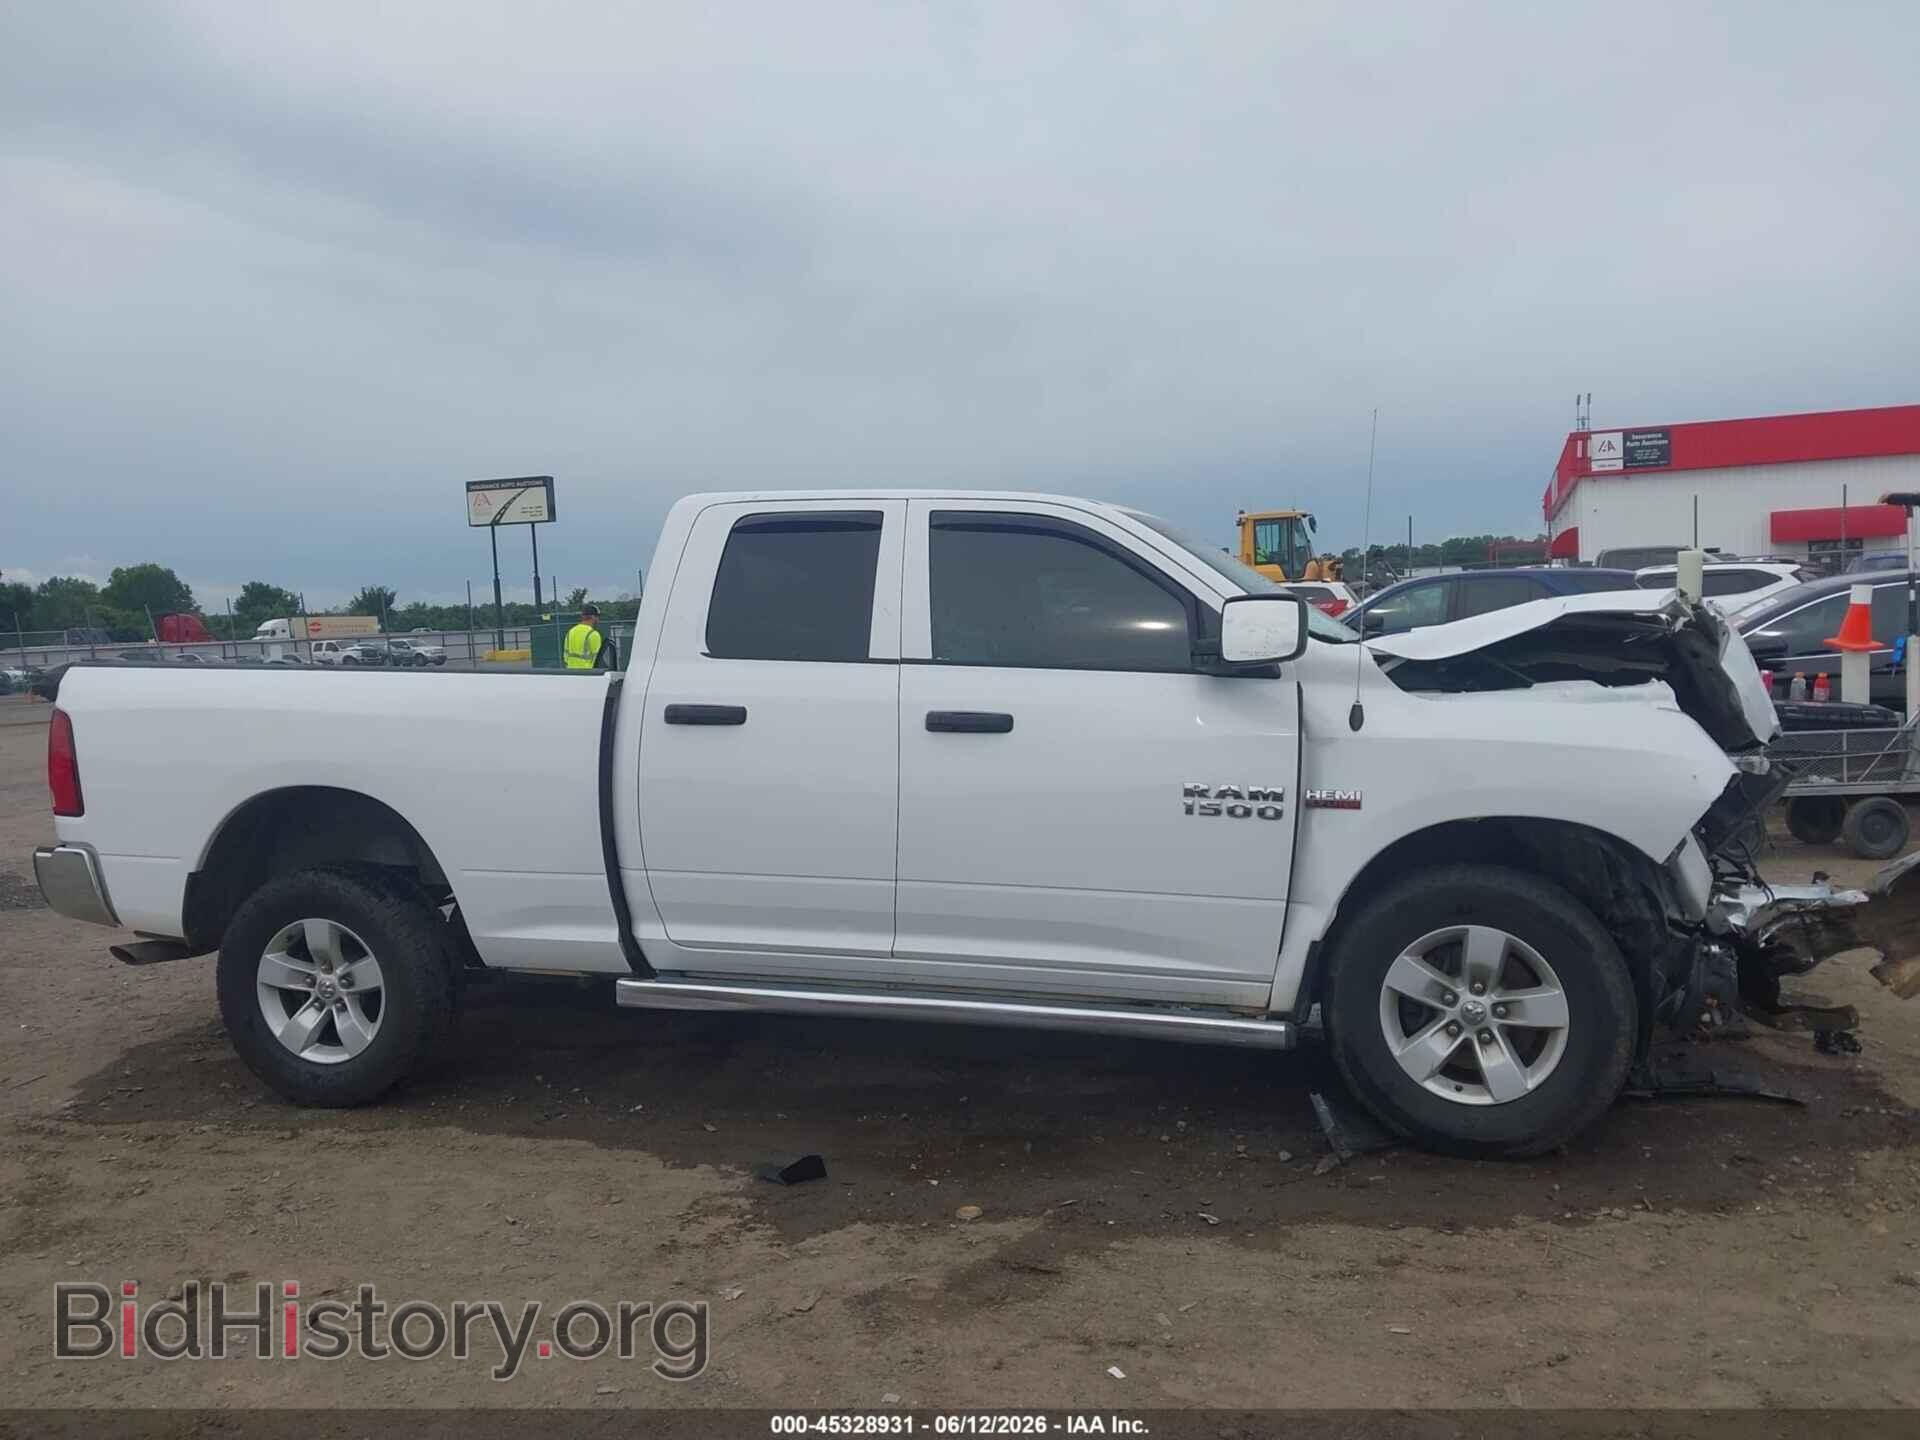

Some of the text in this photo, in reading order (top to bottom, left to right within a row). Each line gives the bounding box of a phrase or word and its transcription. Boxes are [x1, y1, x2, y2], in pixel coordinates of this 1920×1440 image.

[1183, 782, 1284, 801] RAM
[1306, 789, 1361, 800] HEMI
[1183, 799, 1284, 820] 1500
